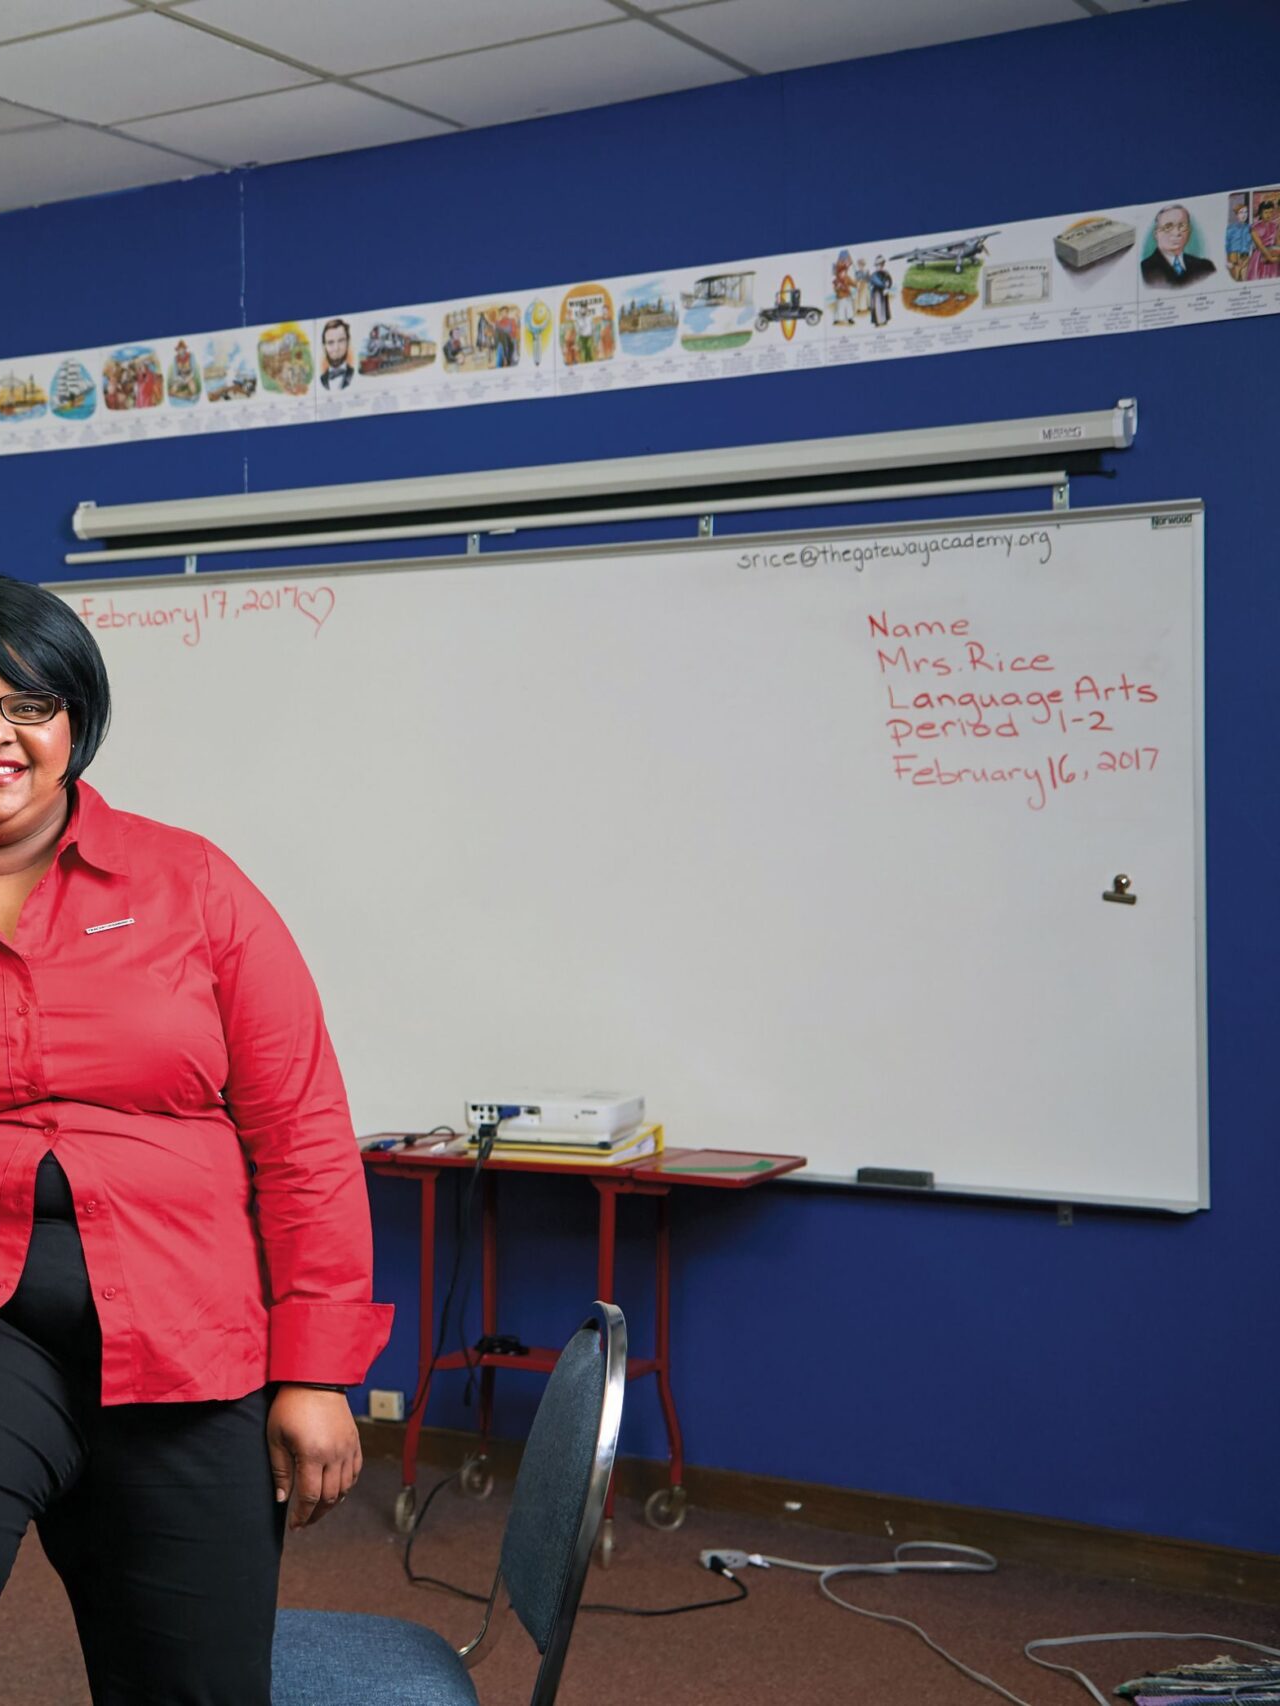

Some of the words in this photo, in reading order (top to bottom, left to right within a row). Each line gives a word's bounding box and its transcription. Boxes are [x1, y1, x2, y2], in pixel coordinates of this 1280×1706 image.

[737, 531, 1053, 571] srice@thegatewayacademy.org
[868, 611, 969, 638] Name
[965, 641, 1055, 672] Rice
[888, 686, 1063, 724] Language
[1074, 674, 1158, 702] Arts
[1059, 710, 1113, 733] 1-2
[892, 755, 1046, 811] February
[1097, 748, 1159, 772] 2017
